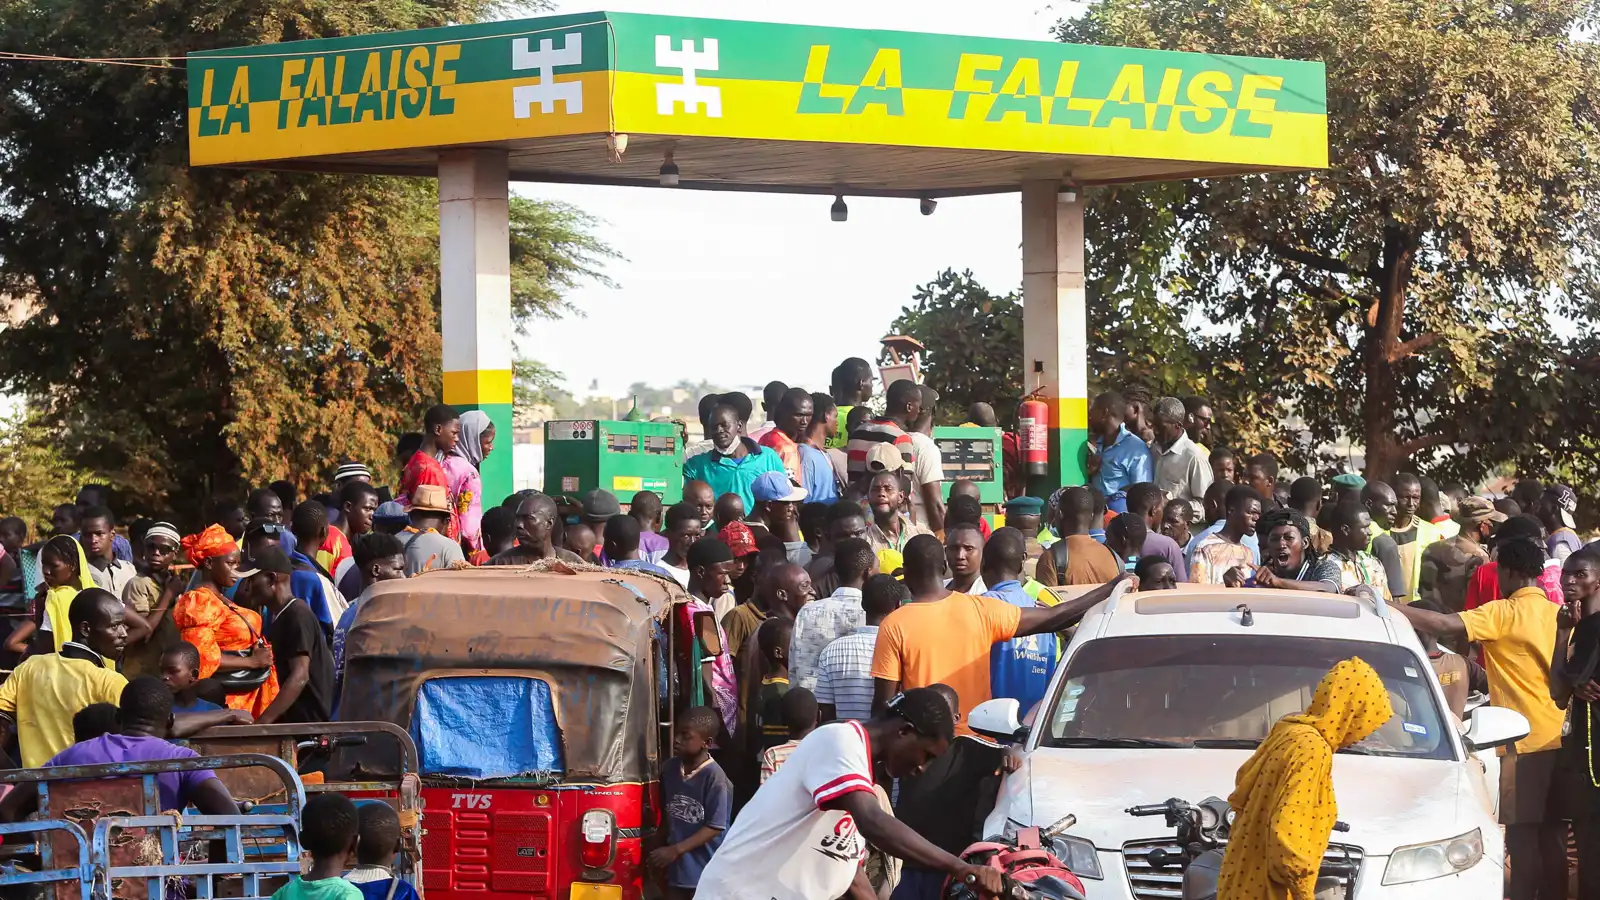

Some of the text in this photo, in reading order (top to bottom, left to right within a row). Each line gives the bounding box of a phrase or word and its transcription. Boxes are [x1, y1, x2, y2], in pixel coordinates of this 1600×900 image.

[197, 43, 463, 138] LA FALAISE
[796, 44, 1284, 138] LA FALAISE
[451, 793, 493, 810] TVS
